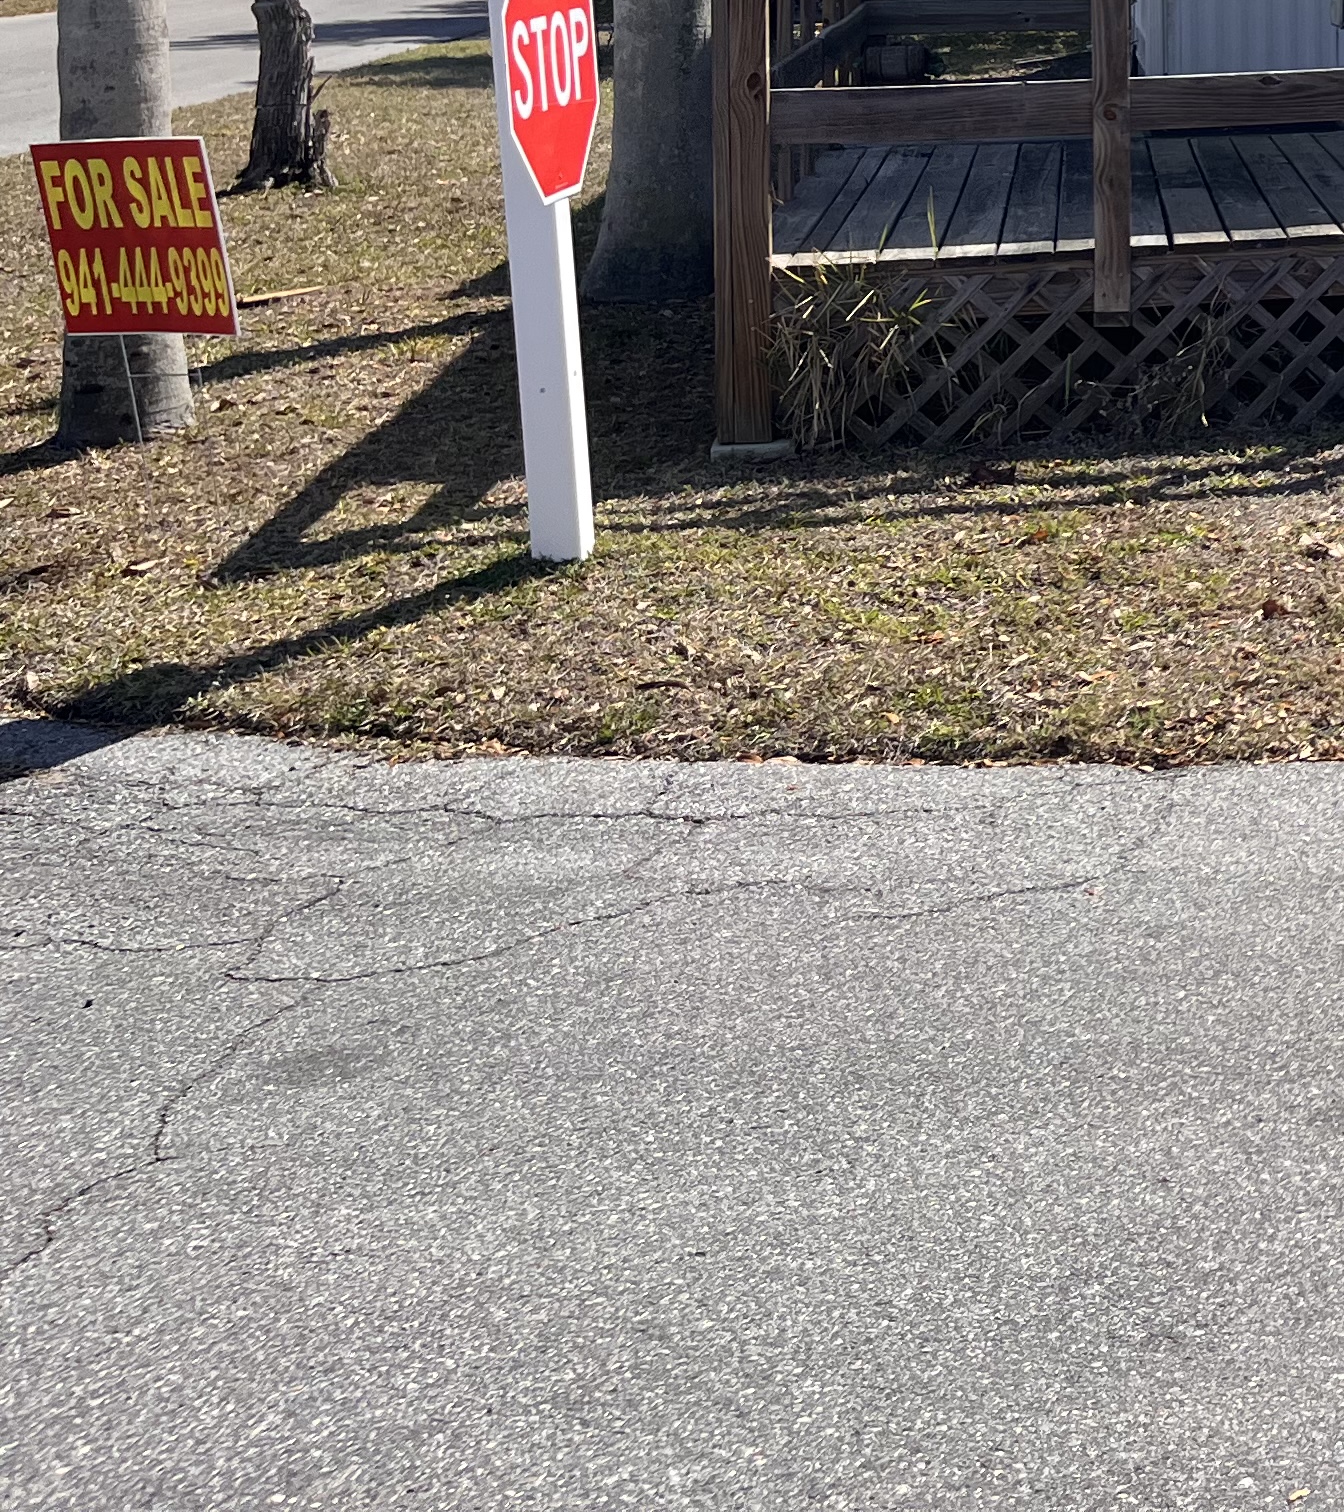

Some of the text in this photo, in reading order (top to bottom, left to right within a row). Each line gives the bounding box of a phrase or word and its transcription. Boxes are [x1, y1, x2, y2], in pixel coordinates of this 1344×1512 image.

[511, 7, 589, 120] STOP
[39, 156, 214, 230] FOR SALE
[57, 246, 230, 317] 941-444-9399
